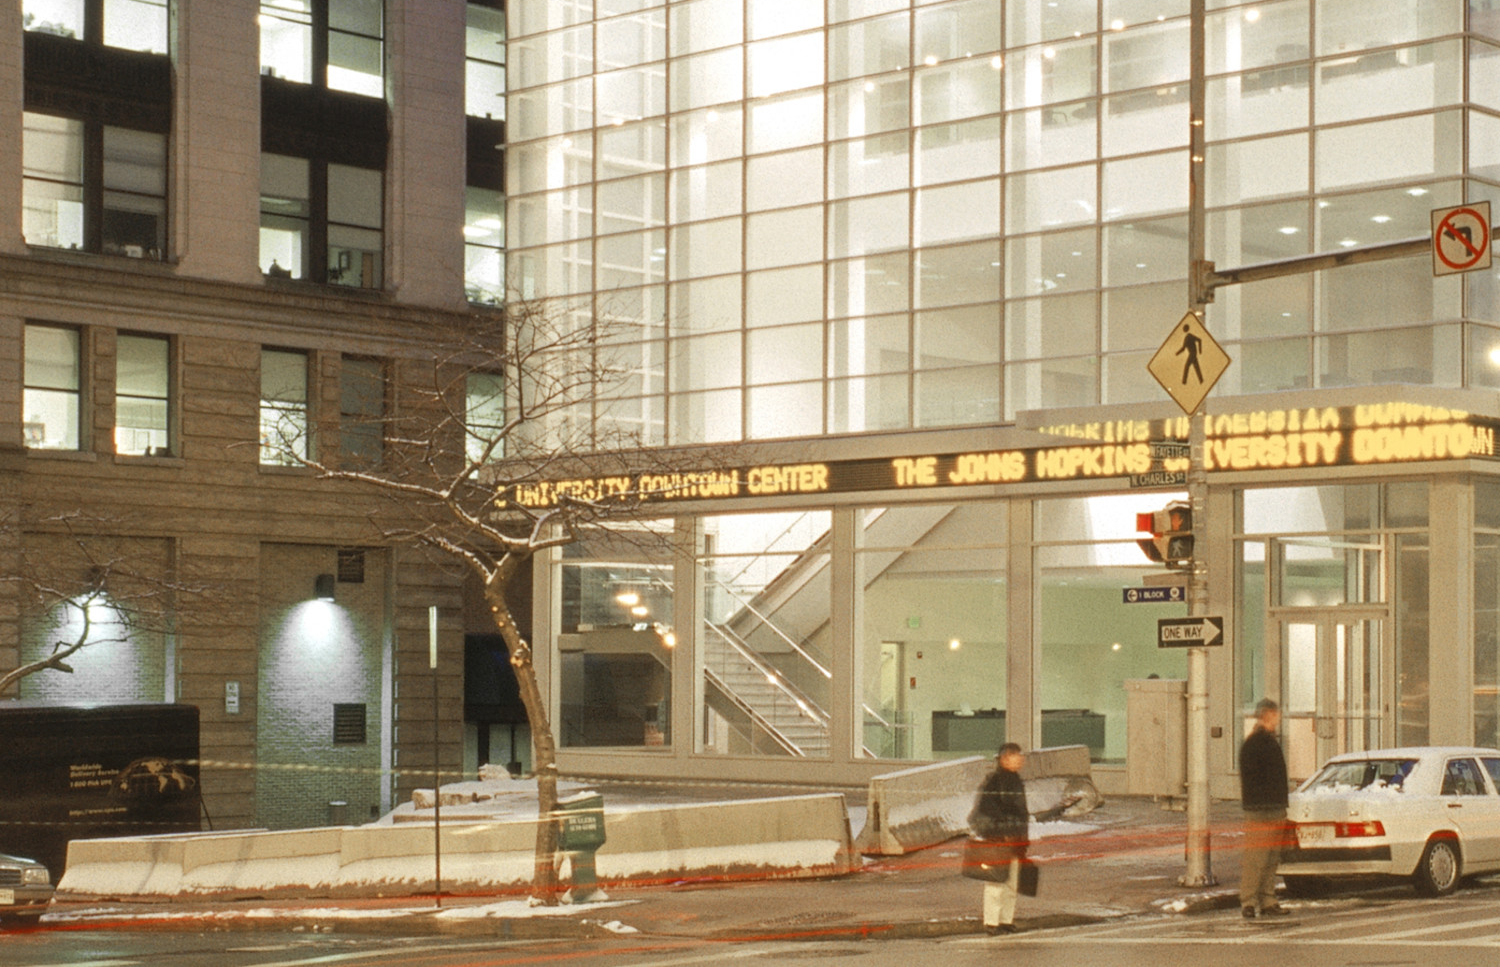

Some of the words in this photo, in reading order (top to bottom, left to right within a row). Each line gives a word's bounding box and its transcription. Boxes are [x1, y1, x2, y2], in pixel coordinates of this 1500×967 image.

[892, 457, 937, 486] THE
[949, 451, 1026, 484] JOHNS
[1036, 443, 1151, 479] HOPKINS
[747, 463, 829, 494] CENTER
[1140, 472, 1176, 485] CHARLES
[1143, 591, 1164, 599] BLOCK
[1163, 627, 1181, 639] ONE
[1184, 626, 1202, 639] WAY
